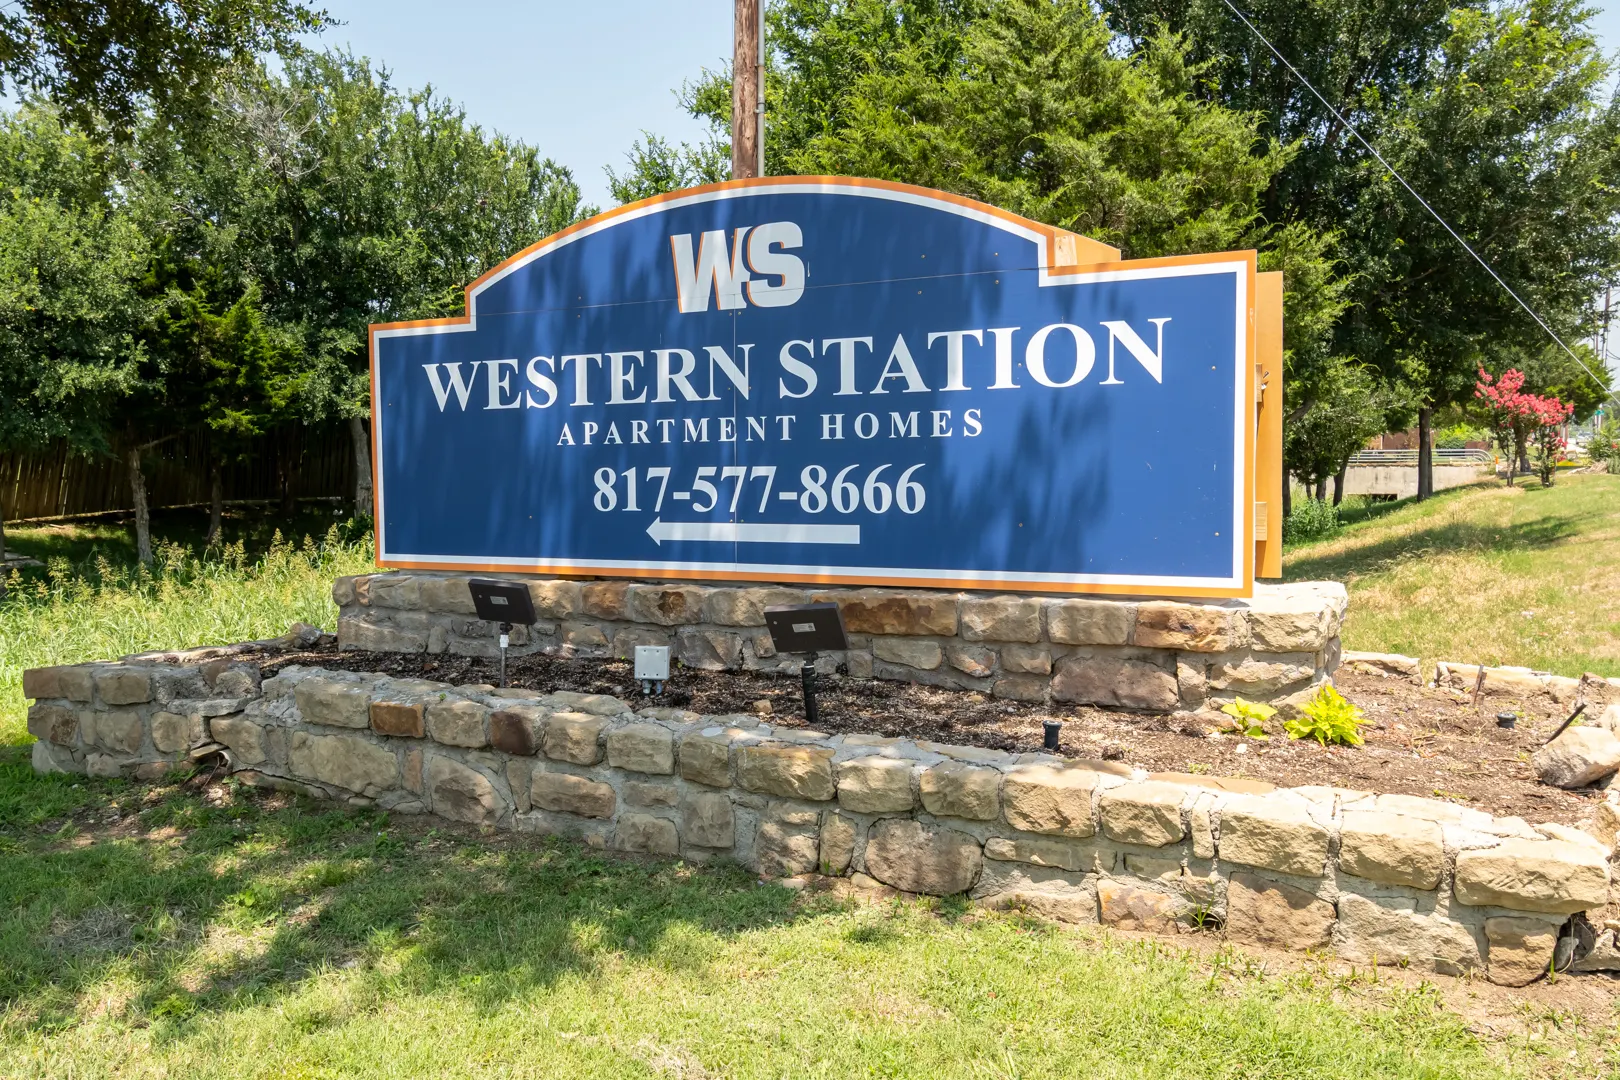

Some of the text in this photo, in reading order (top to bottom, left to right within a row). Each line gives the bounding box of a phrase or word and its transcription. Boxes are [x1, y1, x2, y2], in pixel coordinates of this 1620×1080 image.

[670, 221, 806, 314] WS
[421, 317, 1173, 413] WESTERN STATION
[556, 409, 983, 446] APARTMENT HOMES
[593, 463, 926, 514] 817-577-8666
